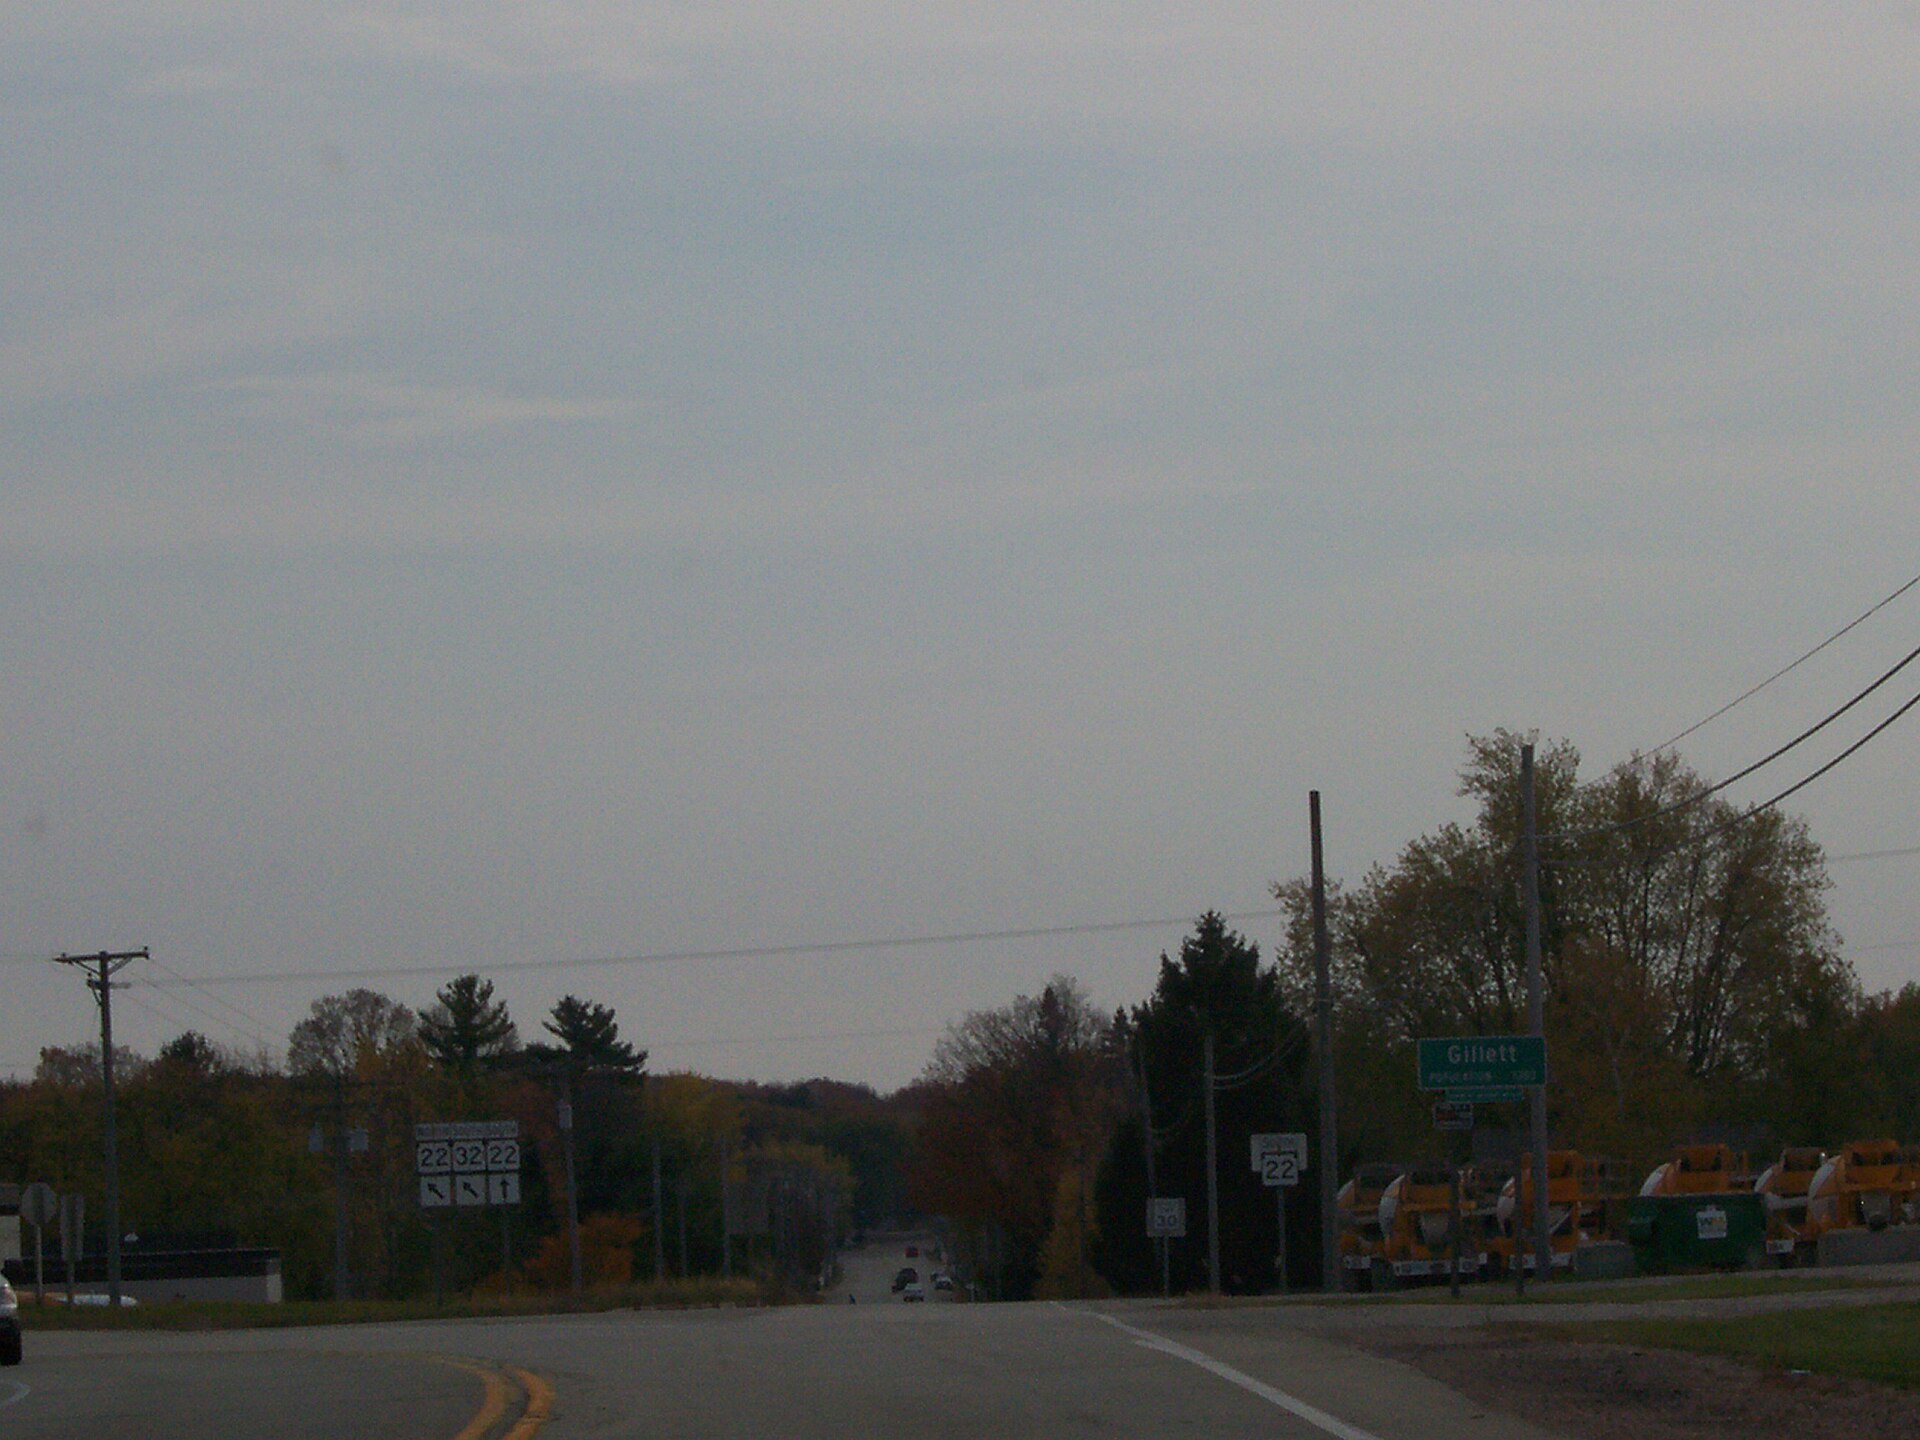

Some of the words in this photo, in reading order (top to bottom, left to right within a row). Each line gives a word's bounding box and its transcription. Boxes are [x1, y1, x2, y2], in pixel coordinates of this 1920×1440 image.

[1446, 1044, 1518, 1064] Gillett
[420, 1147, 449, 1167] 22
[456, 1146, 482, 1165] 32
[489, 1145, 517, 1164] 22
[1266, 1160, 1295, 1180] 22
